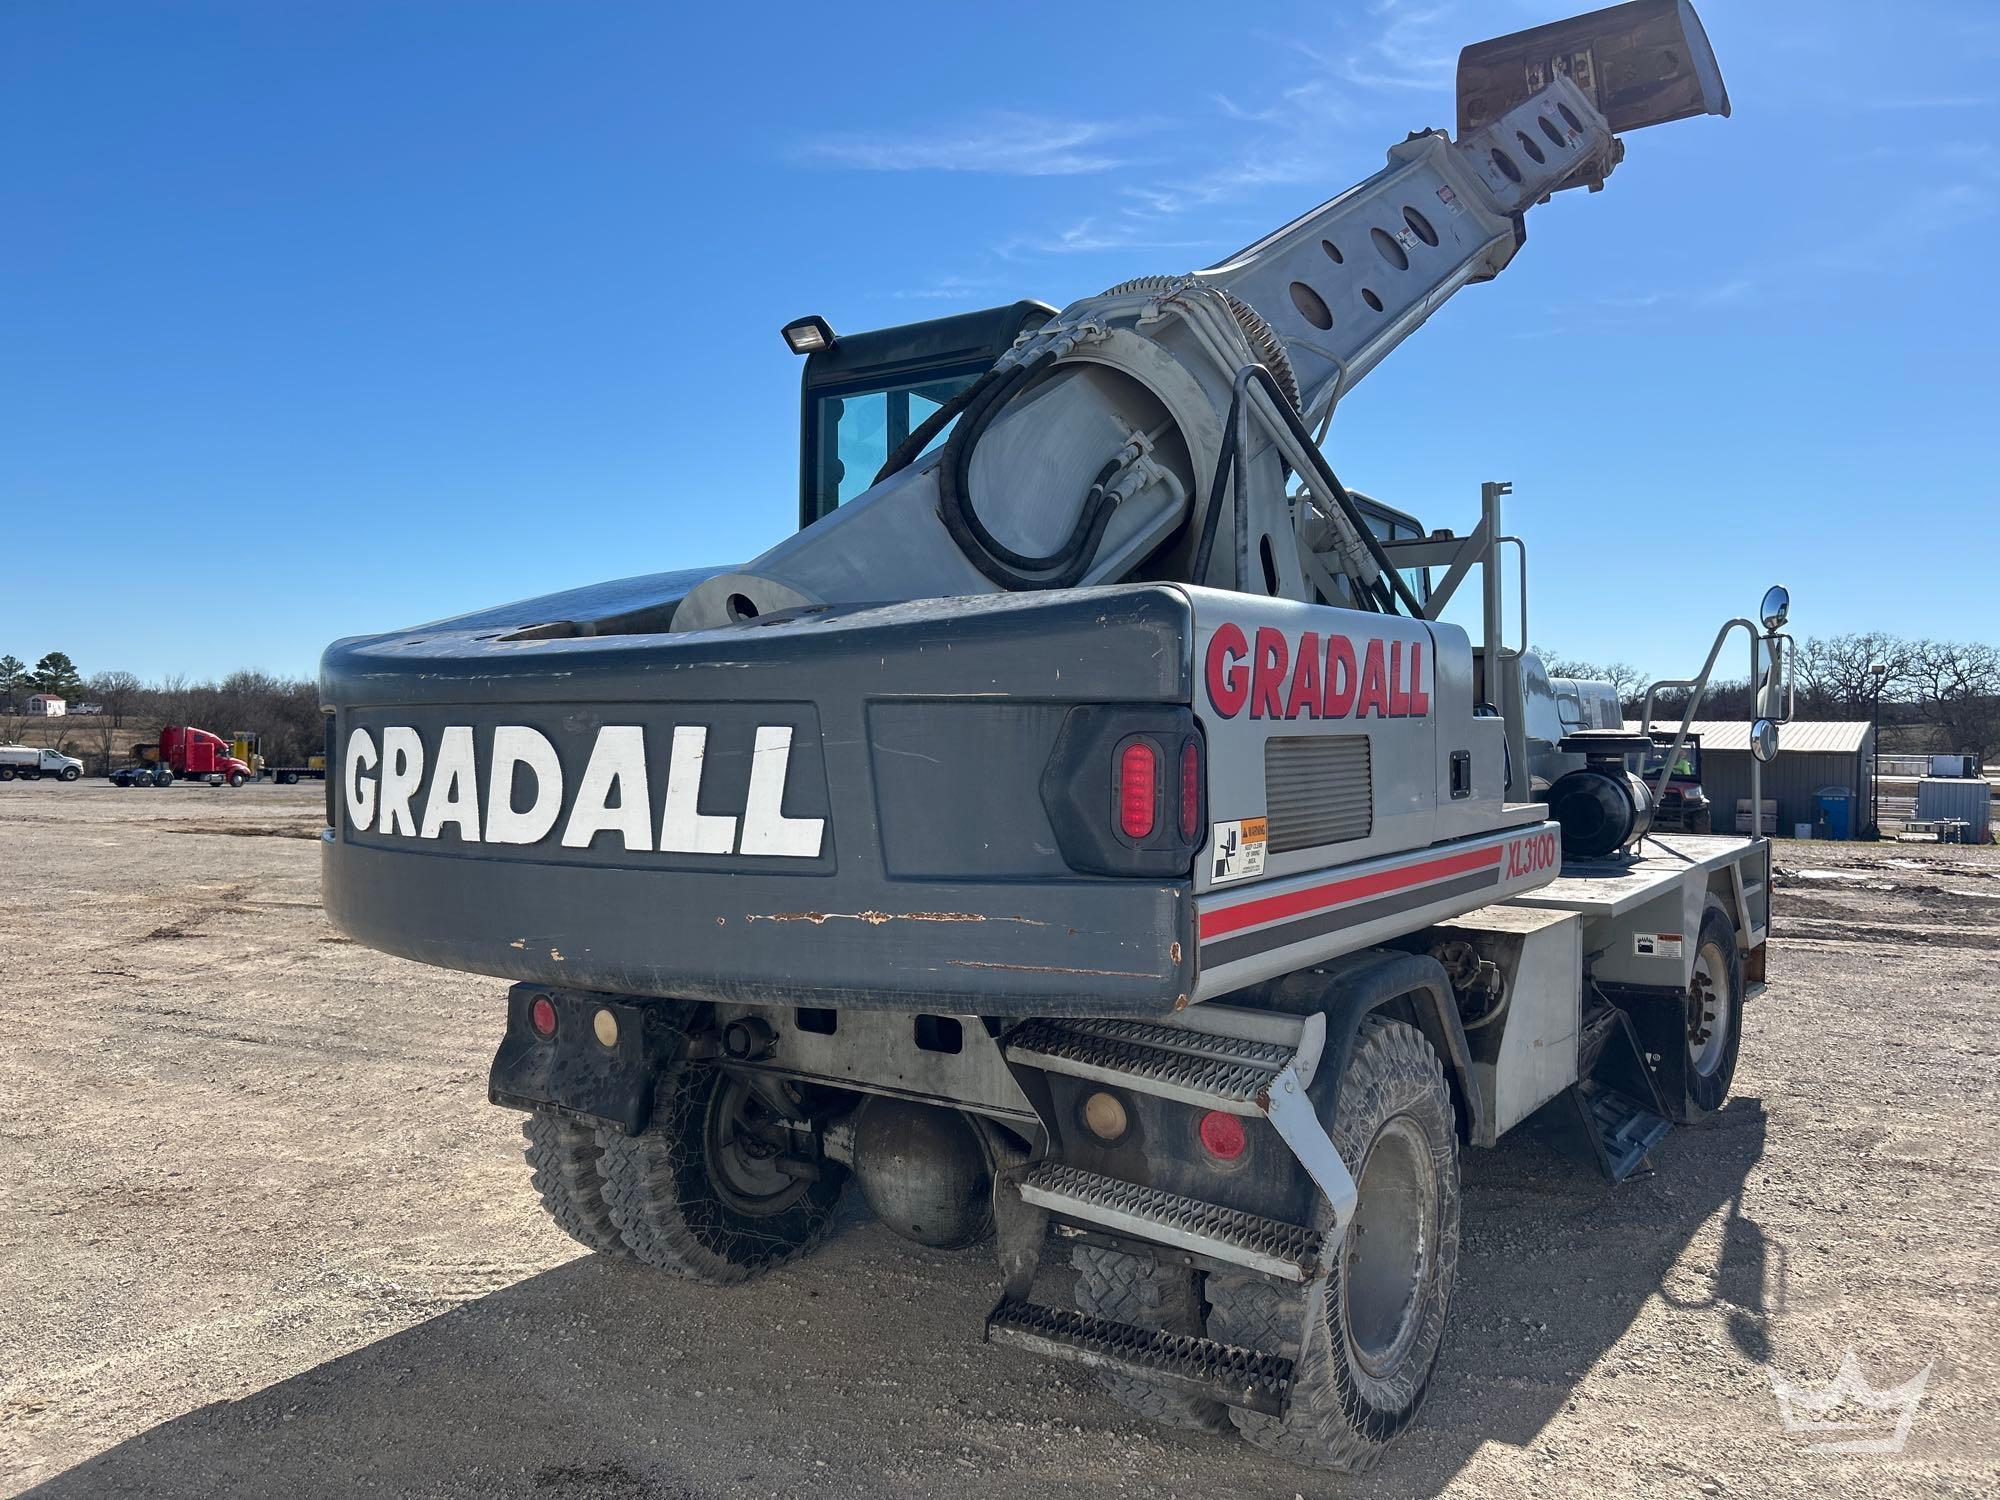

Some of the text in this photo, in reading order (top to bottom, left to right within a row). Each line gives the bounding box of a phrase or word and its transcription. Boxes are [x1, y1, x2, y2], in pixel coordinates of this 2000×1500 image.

[1204, 622, 1429, 720] GRADALL
[345, 726, 825, 857] GRADALL
[1505, 832, 1555, 880] XL3100
